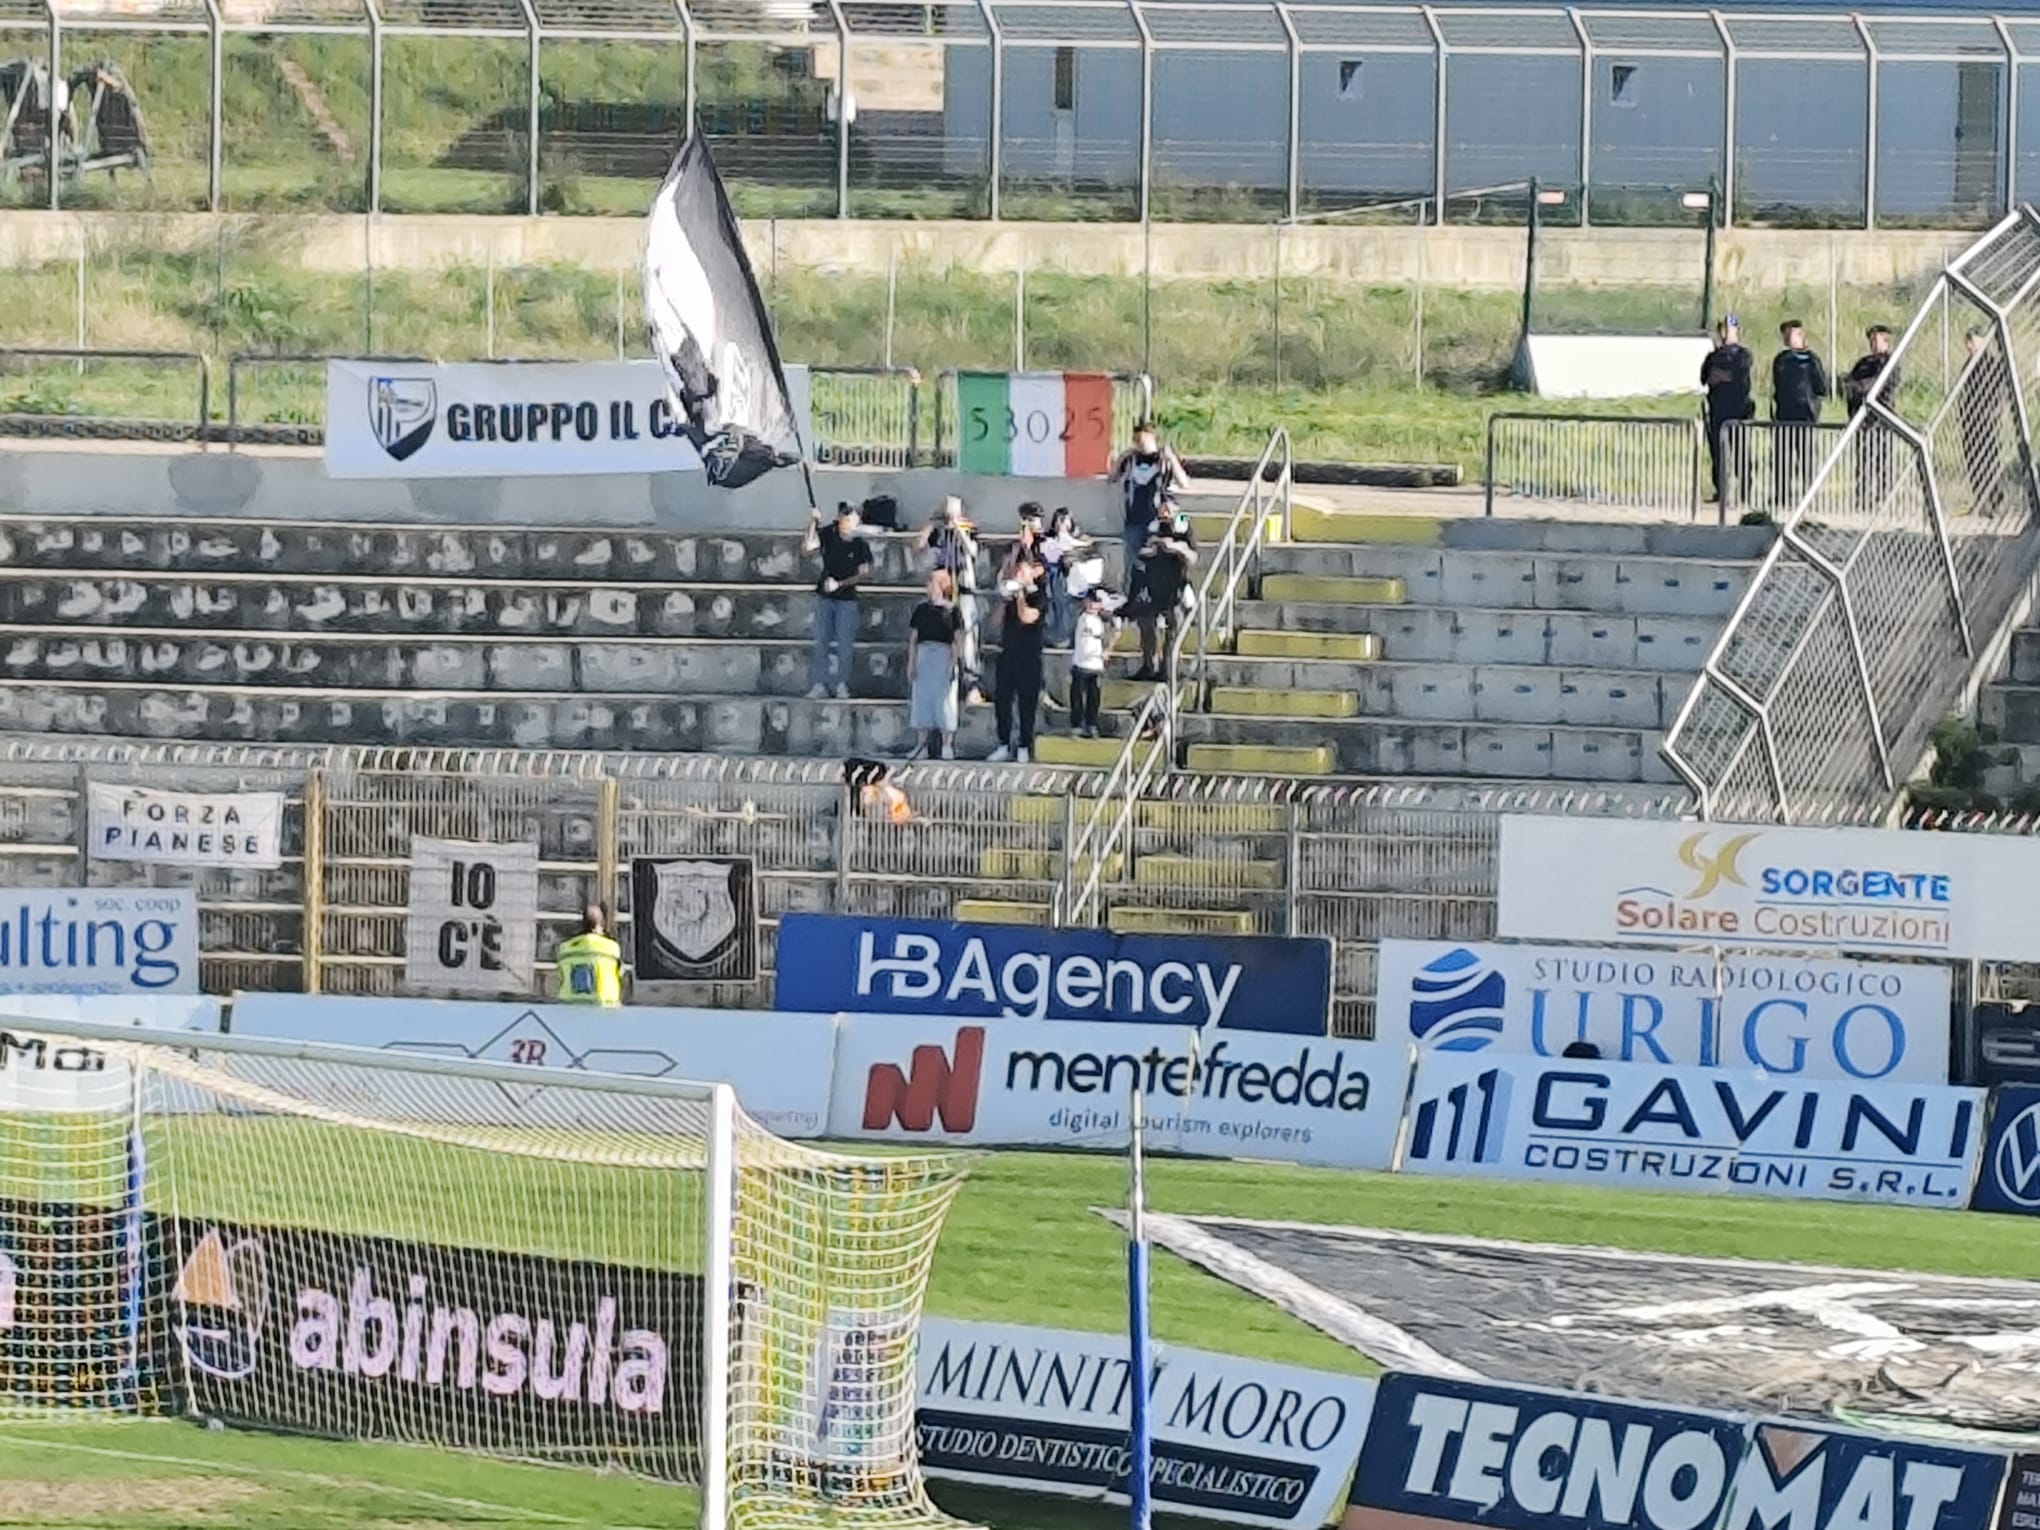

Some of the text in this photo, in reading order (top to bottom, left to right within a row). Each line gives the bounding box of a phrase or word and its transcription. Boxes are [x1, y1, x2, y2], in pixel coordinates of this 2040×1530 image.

[447, 400, 598, 443] GRUPPO
[610, 400, 640, 441] IL
[123, 800, 241, 825] FORZA
[105, 827, 259, 854] PIANESE
[1761, 867, 1950, 901] SORGENTE
[1616, 900, 1950, 943] Solare Costruzioni
[1534, 958, 1902, 998] STUDIO RADIOLOGICO
[1527, 986, 1907, 1079] URIGO
[1005, 1041, 1371, 1112] mentefredda
[1049, 1111, 1313, 1144] digital ourism explorers
[1531, 1071, 1973, 1159] GAVINI
[1524, 1144, 1959, 1198] COSTRUZIONI S.R.L.
[290, 1267, 668, 1414] abinsula
[1166, 1371, 1348, 1453] MORO
[1149, 1457, 1306, 1505] PECIALISTICO
[1404, 1391, 1966, 1530] TECNOMAT
